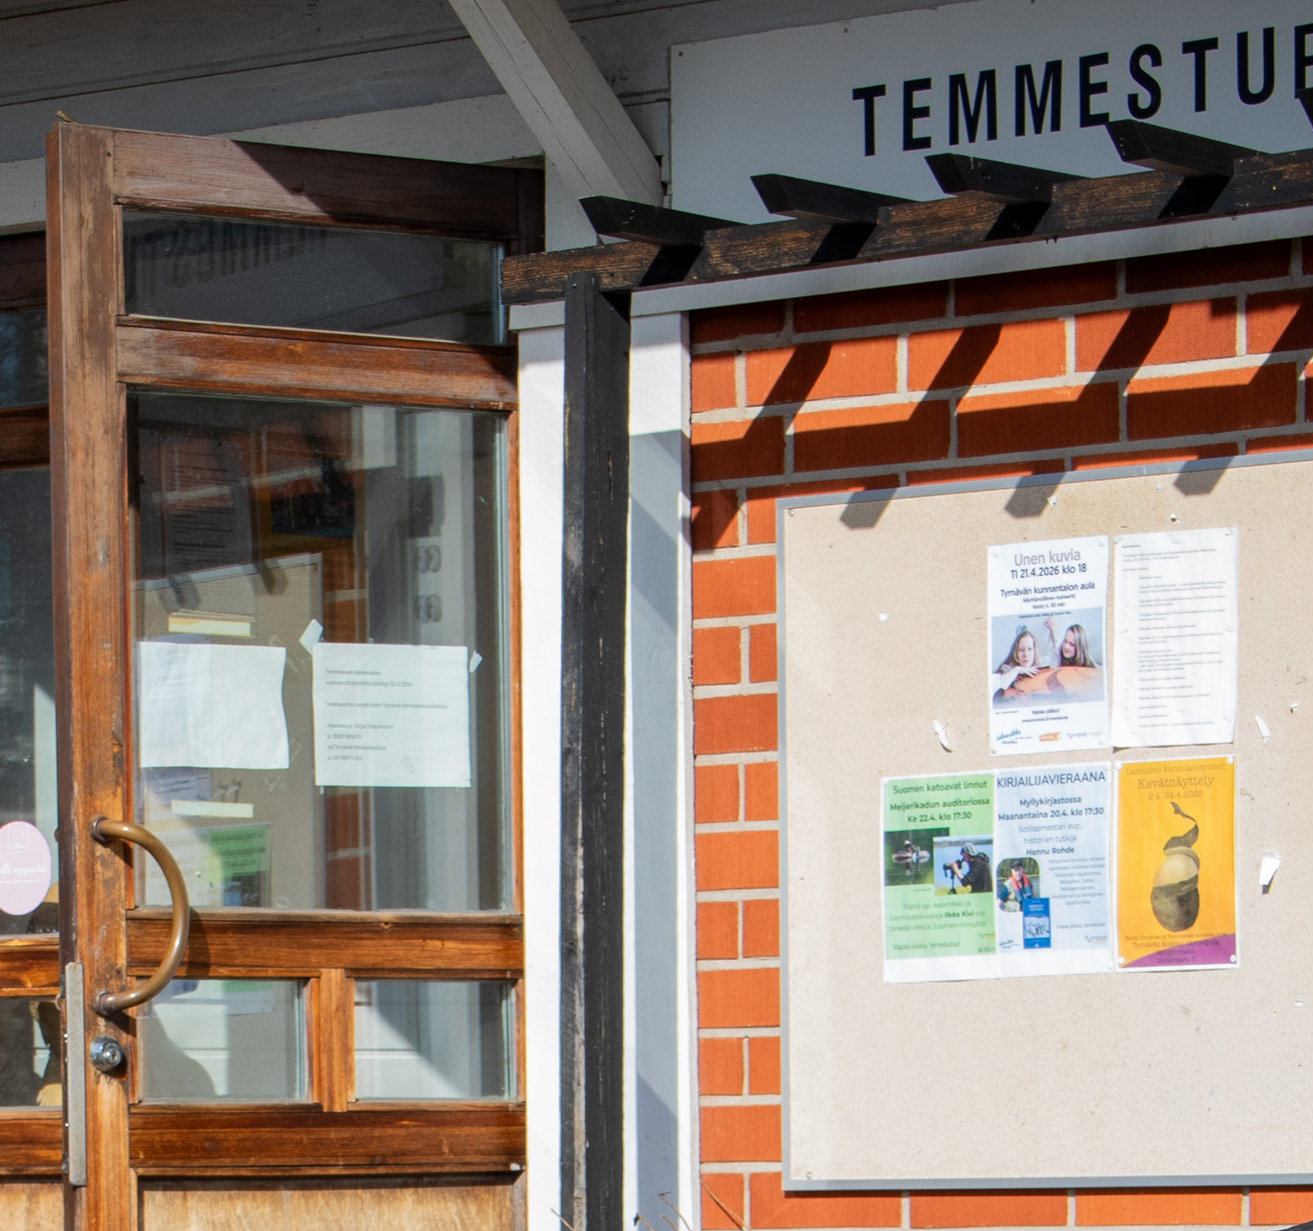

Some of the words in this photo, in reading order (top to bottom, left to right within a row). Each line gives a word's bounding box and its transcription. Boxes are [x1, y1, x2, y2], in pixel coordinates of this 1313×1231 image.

[1014, 553, 1045, 566] Unen
[1048, 549, 1081, 564] kuvia
[1020, 565, 1060, 578] 21.4.2026
[1062, 564, 1076, 574] klo
[1078, 563, 1087, 573] 18
[1000, 587, 1032, 598] Tyrnävän
[1034, 583, 1078, 594] kunnantalon
[1080, 581, 1095, 590] aula
[997, 771, 1106, 788] KIRJAILIJAVIERAANA
[1137, 775, 1214, 789] Kevätnäyttely
[893, 785, 924, 794] Suomen
[926, 783, 962, 791] katoavat
[963, 781, 988, 789] linnut
[889, 801, 940, 812] Meijerikadun
[942, 797, 990, 807] auditoriossa
[1019, 796, 1082, 808] Myllykirjastossa
[919, 814, 935, 822] 22.4.
[953, 811, 972, 819] 17:30
[998, 811, 1048, 821] Maanantaina
[1050, 809, 1069, 818] 20.4.
[1070, 808, 1083, 816] klo
[1084, 807, 1104, 815] 17:30
[1024, 836, 1053, 844] historian
[1055, 834, 1077, 843] tutkija
[1026, 848, 1050, 856] Hannu
[1052, 846, 1074, 854] Rohde
